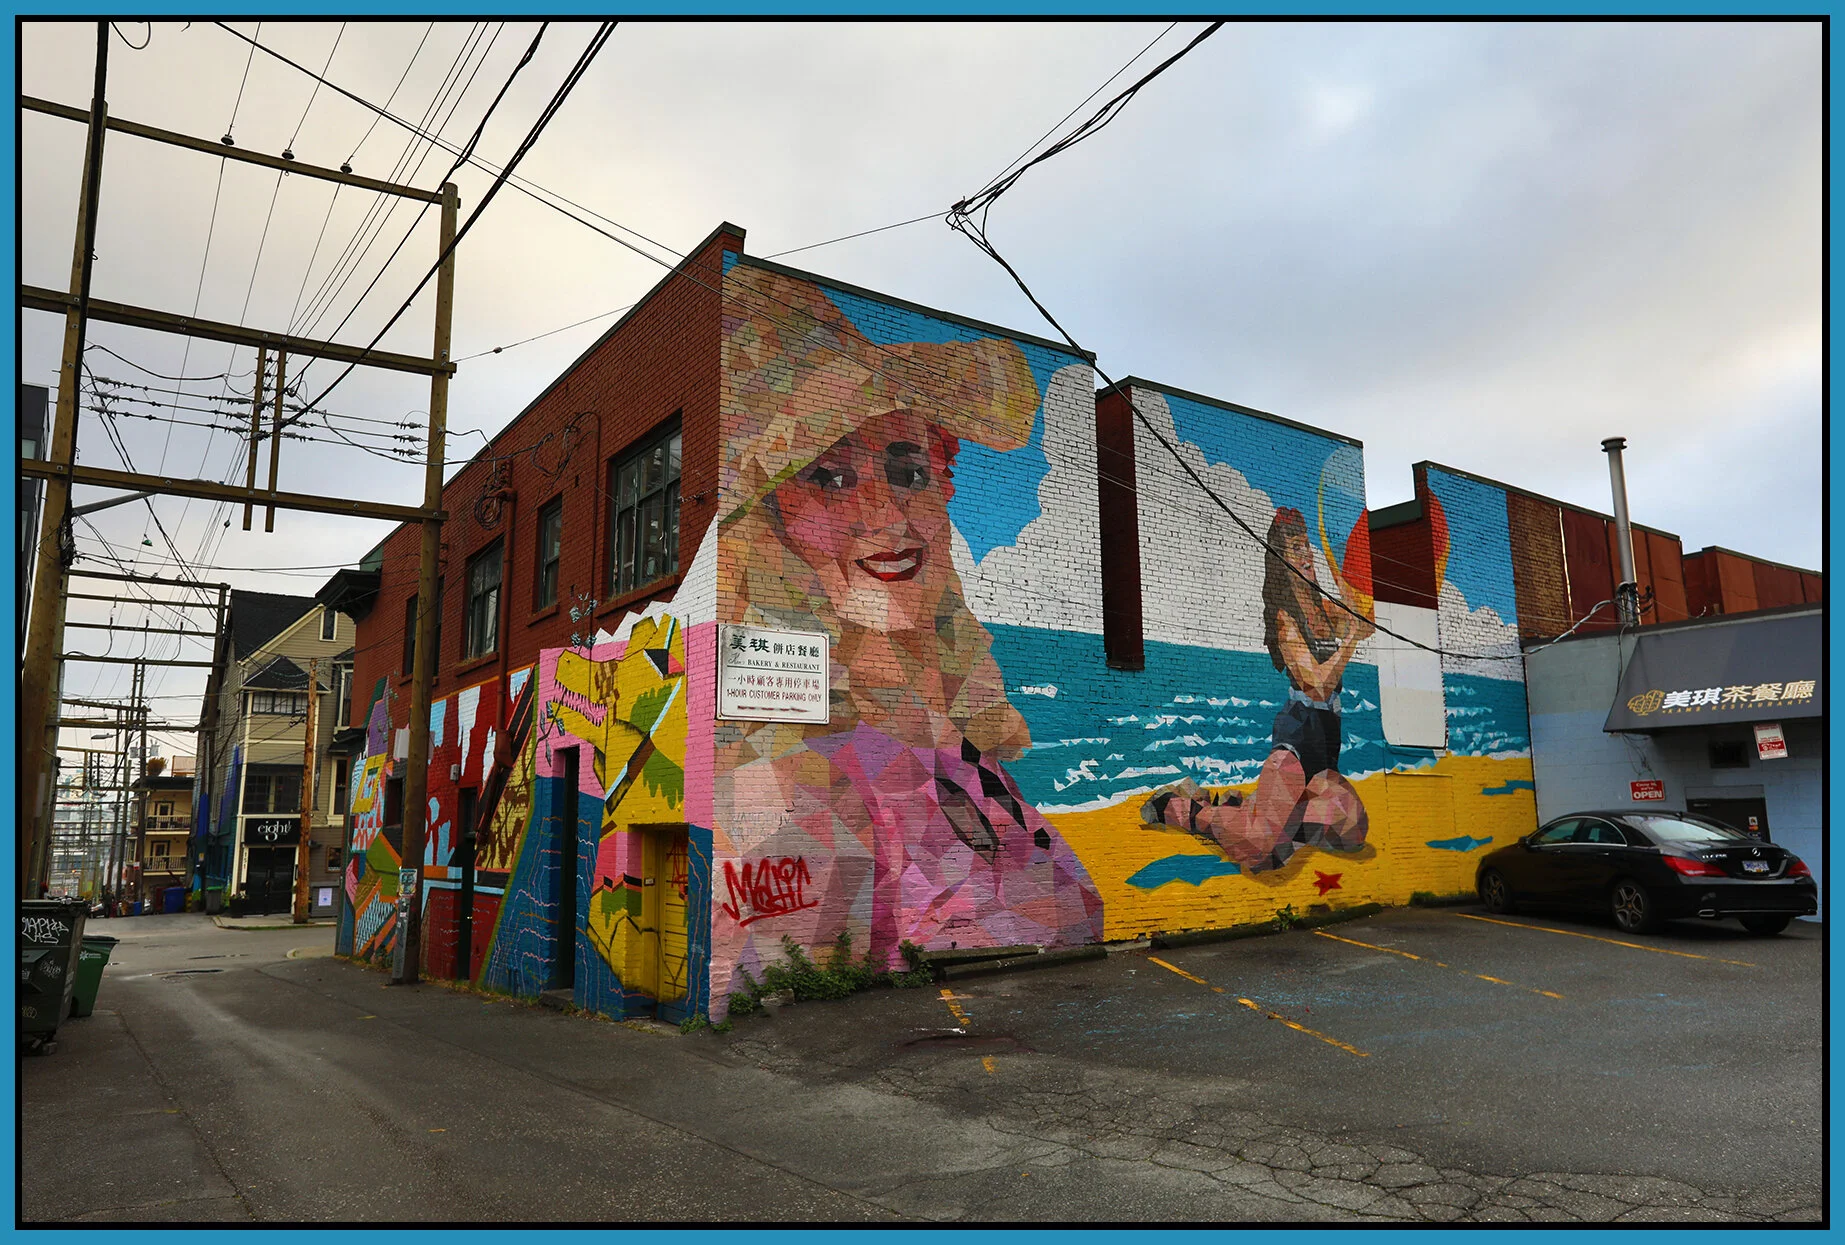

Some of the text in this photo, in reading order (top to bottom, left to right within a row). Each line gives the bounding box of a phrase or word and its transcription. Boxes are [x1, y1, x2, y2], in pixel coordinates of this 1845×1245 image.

[747, 659, 772, 667] BAKERY
[781, 662, 820, 670] RESTAURANT
[748, 690, 780, 700] CUSTOMER
[781, 691, 806, 702] PARKING
[807, 694, 821, 702] ONLY
[1712, 699, 1802, 711] RESTAURANT
[1633, 790, 1662, 799] OPEN
